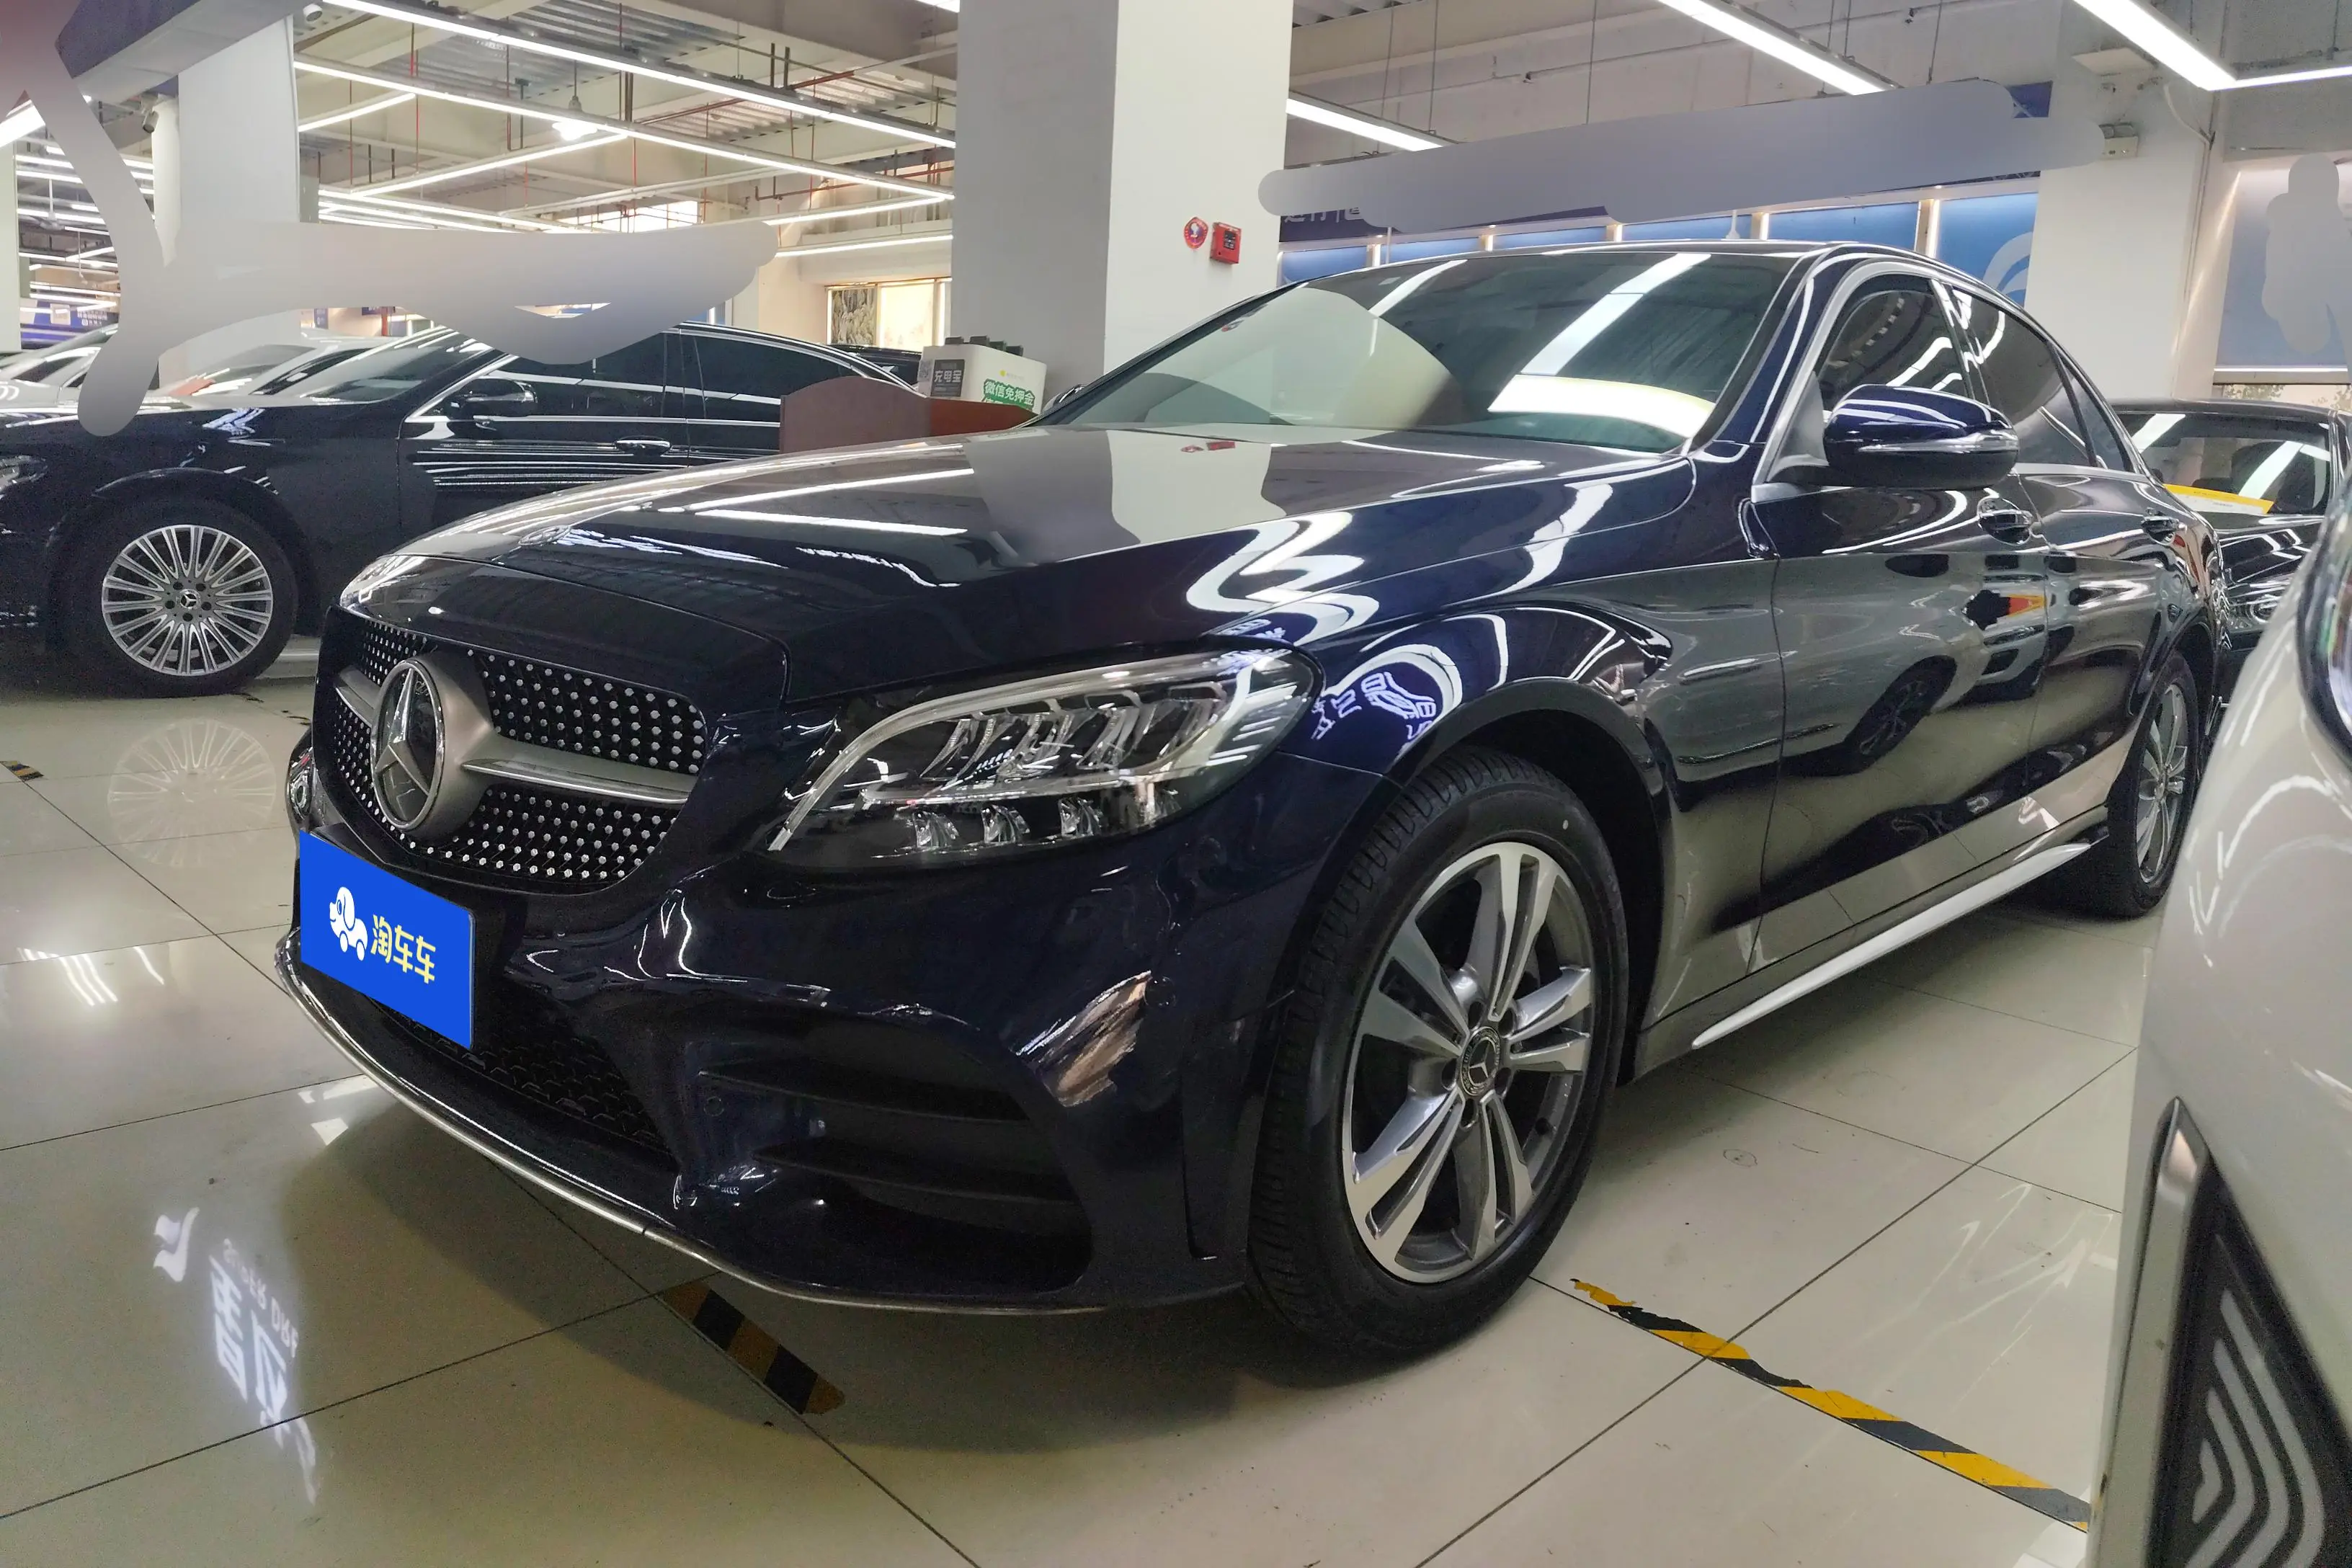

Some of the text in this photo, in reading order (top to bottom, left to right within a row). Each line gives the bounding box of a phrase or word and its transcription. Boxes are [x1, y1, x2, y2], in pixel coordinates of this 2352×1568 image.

[934, 370, 962, 383] 充电宝
[984, 380, 1033, 406] 微信免押金
